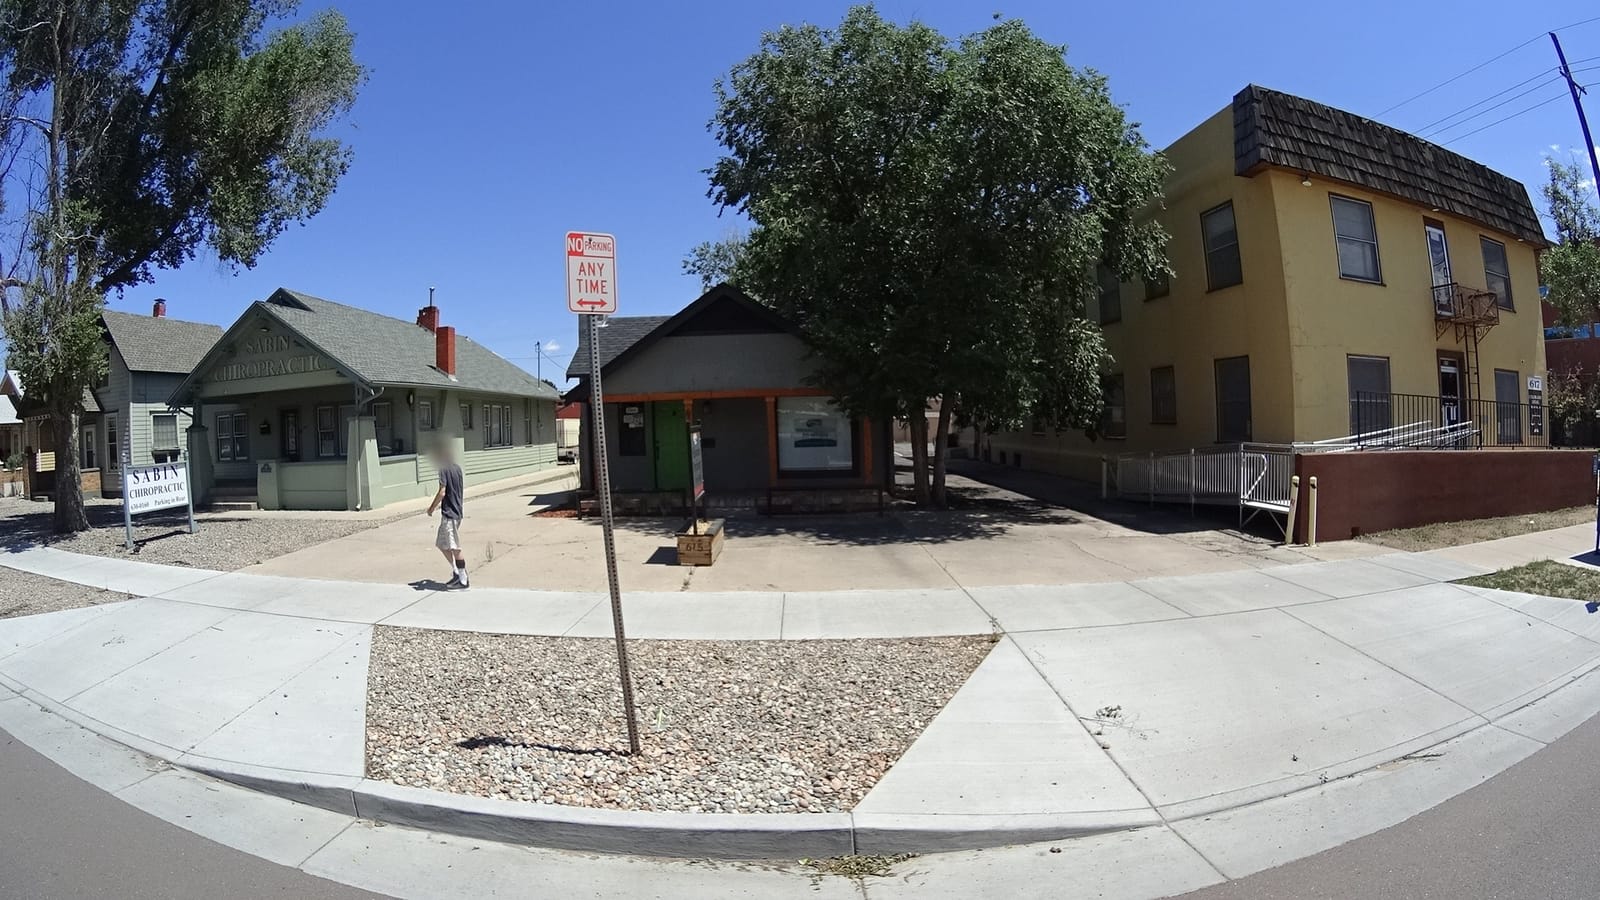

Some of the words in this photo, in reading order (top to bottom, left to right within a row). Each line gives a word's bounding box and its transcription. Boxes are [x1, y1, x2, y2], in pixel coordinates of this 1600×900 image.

[567, 237, 583, 252] NO
[584, 240, 612, 252] PARKING
[578, 262, 604, 276] ANY
[576, 278, 608, 294] TIME
[246, 336, 290, 354] SABIN
[215, 354, 325, 381] CHIROPRACTIC
[132, 465, 178, 484] SABIN
[129, 482, 185, 499] CHIROPRACTIC
[154, 498, 171, 506] Parking
